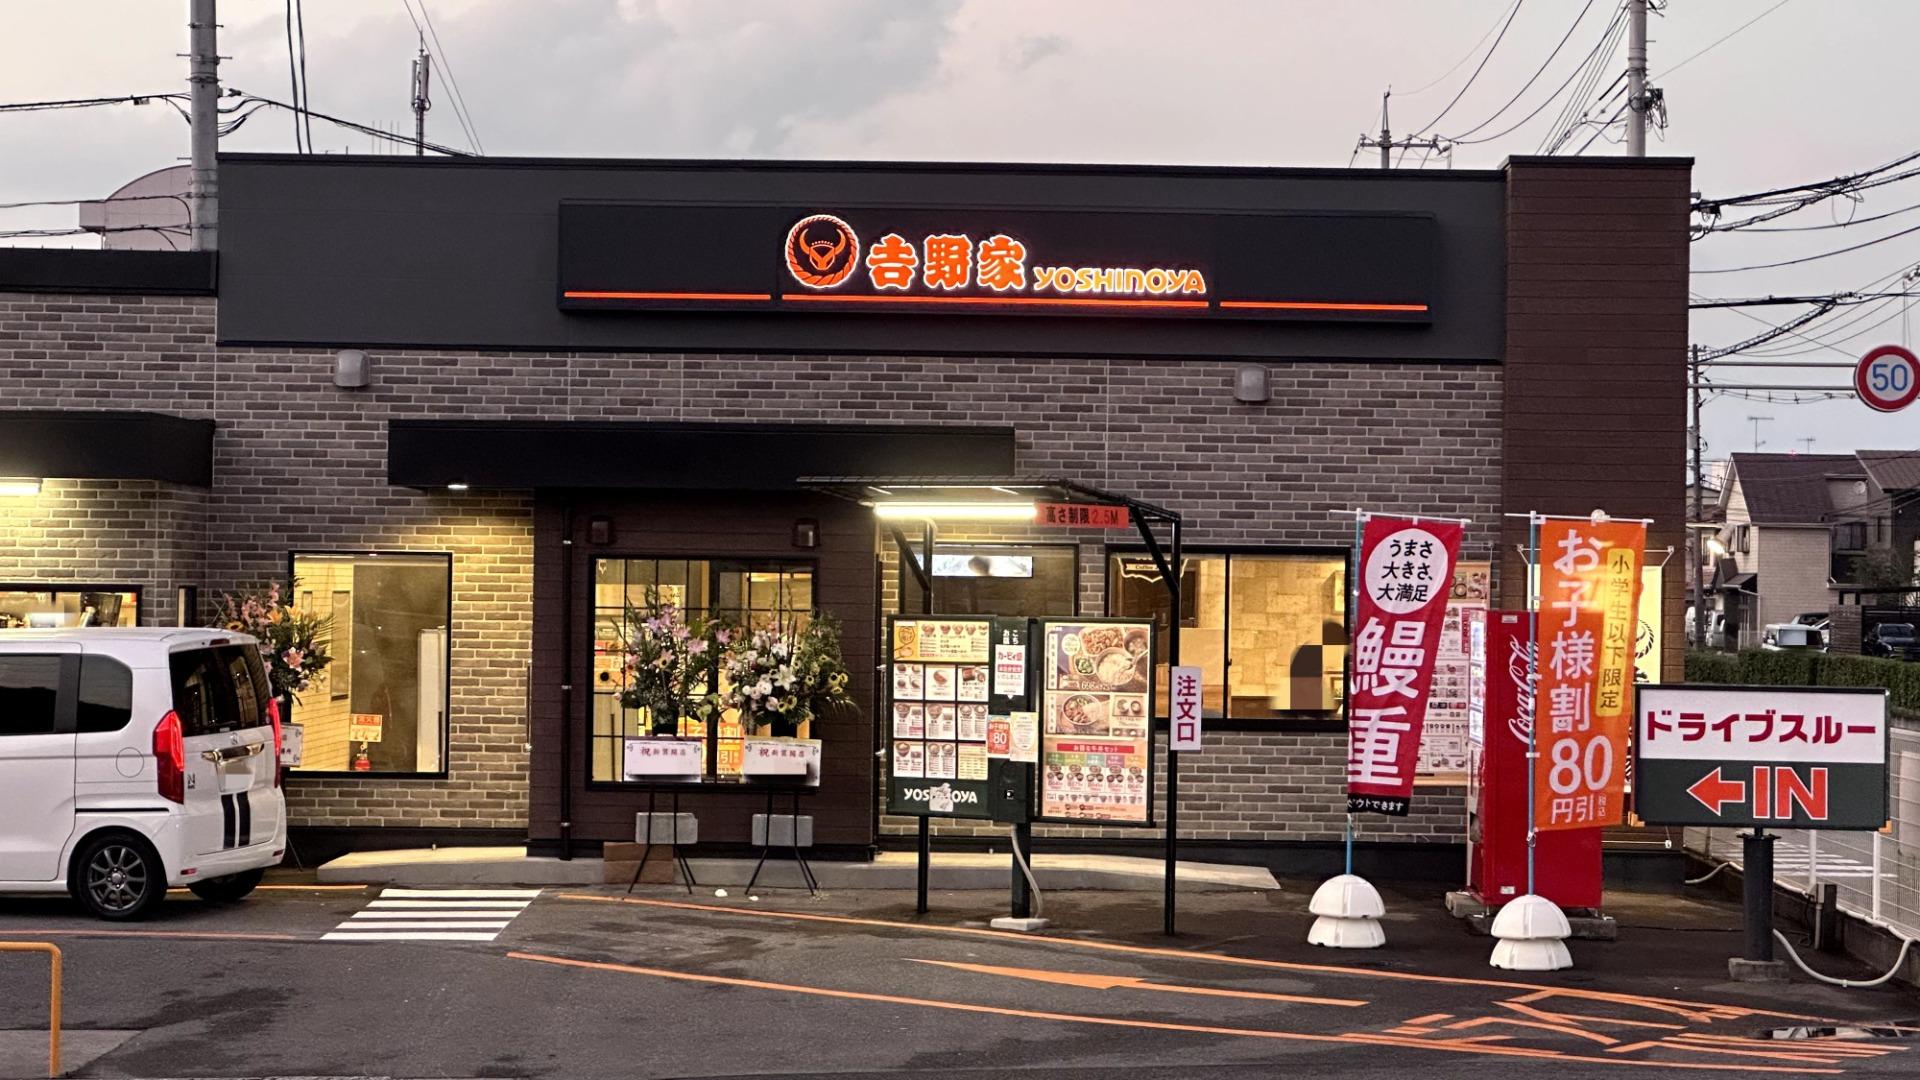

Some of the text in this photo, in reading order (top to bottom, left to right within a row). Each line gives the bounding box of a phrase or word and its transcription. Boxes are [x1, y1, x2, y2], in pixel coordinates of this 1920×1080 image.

[867, 233, 1206, 294] 吉野家 YOSHINOYA
[1872, 363, 1908, 393] 50
[1389, 540, 1433, 558] うまさ
[1377, 584, 1428, 603] 大満足
[1600, 553, 1631, 709] 小学生以下限定
[1177, 675, 1197, 742] 注文口
[1349, 617, 1426, 787] 鰻重
[993, 732, 1007, 744] 80
[1647, 710, 1876, 744] ドライブスルー
[1550, 736, 1613, 795] 80
[904, 787, 978, 804] YOSOYA
[1752, 766, 1829, 820] IN
[1551, 798, 1594, 824] 円引
